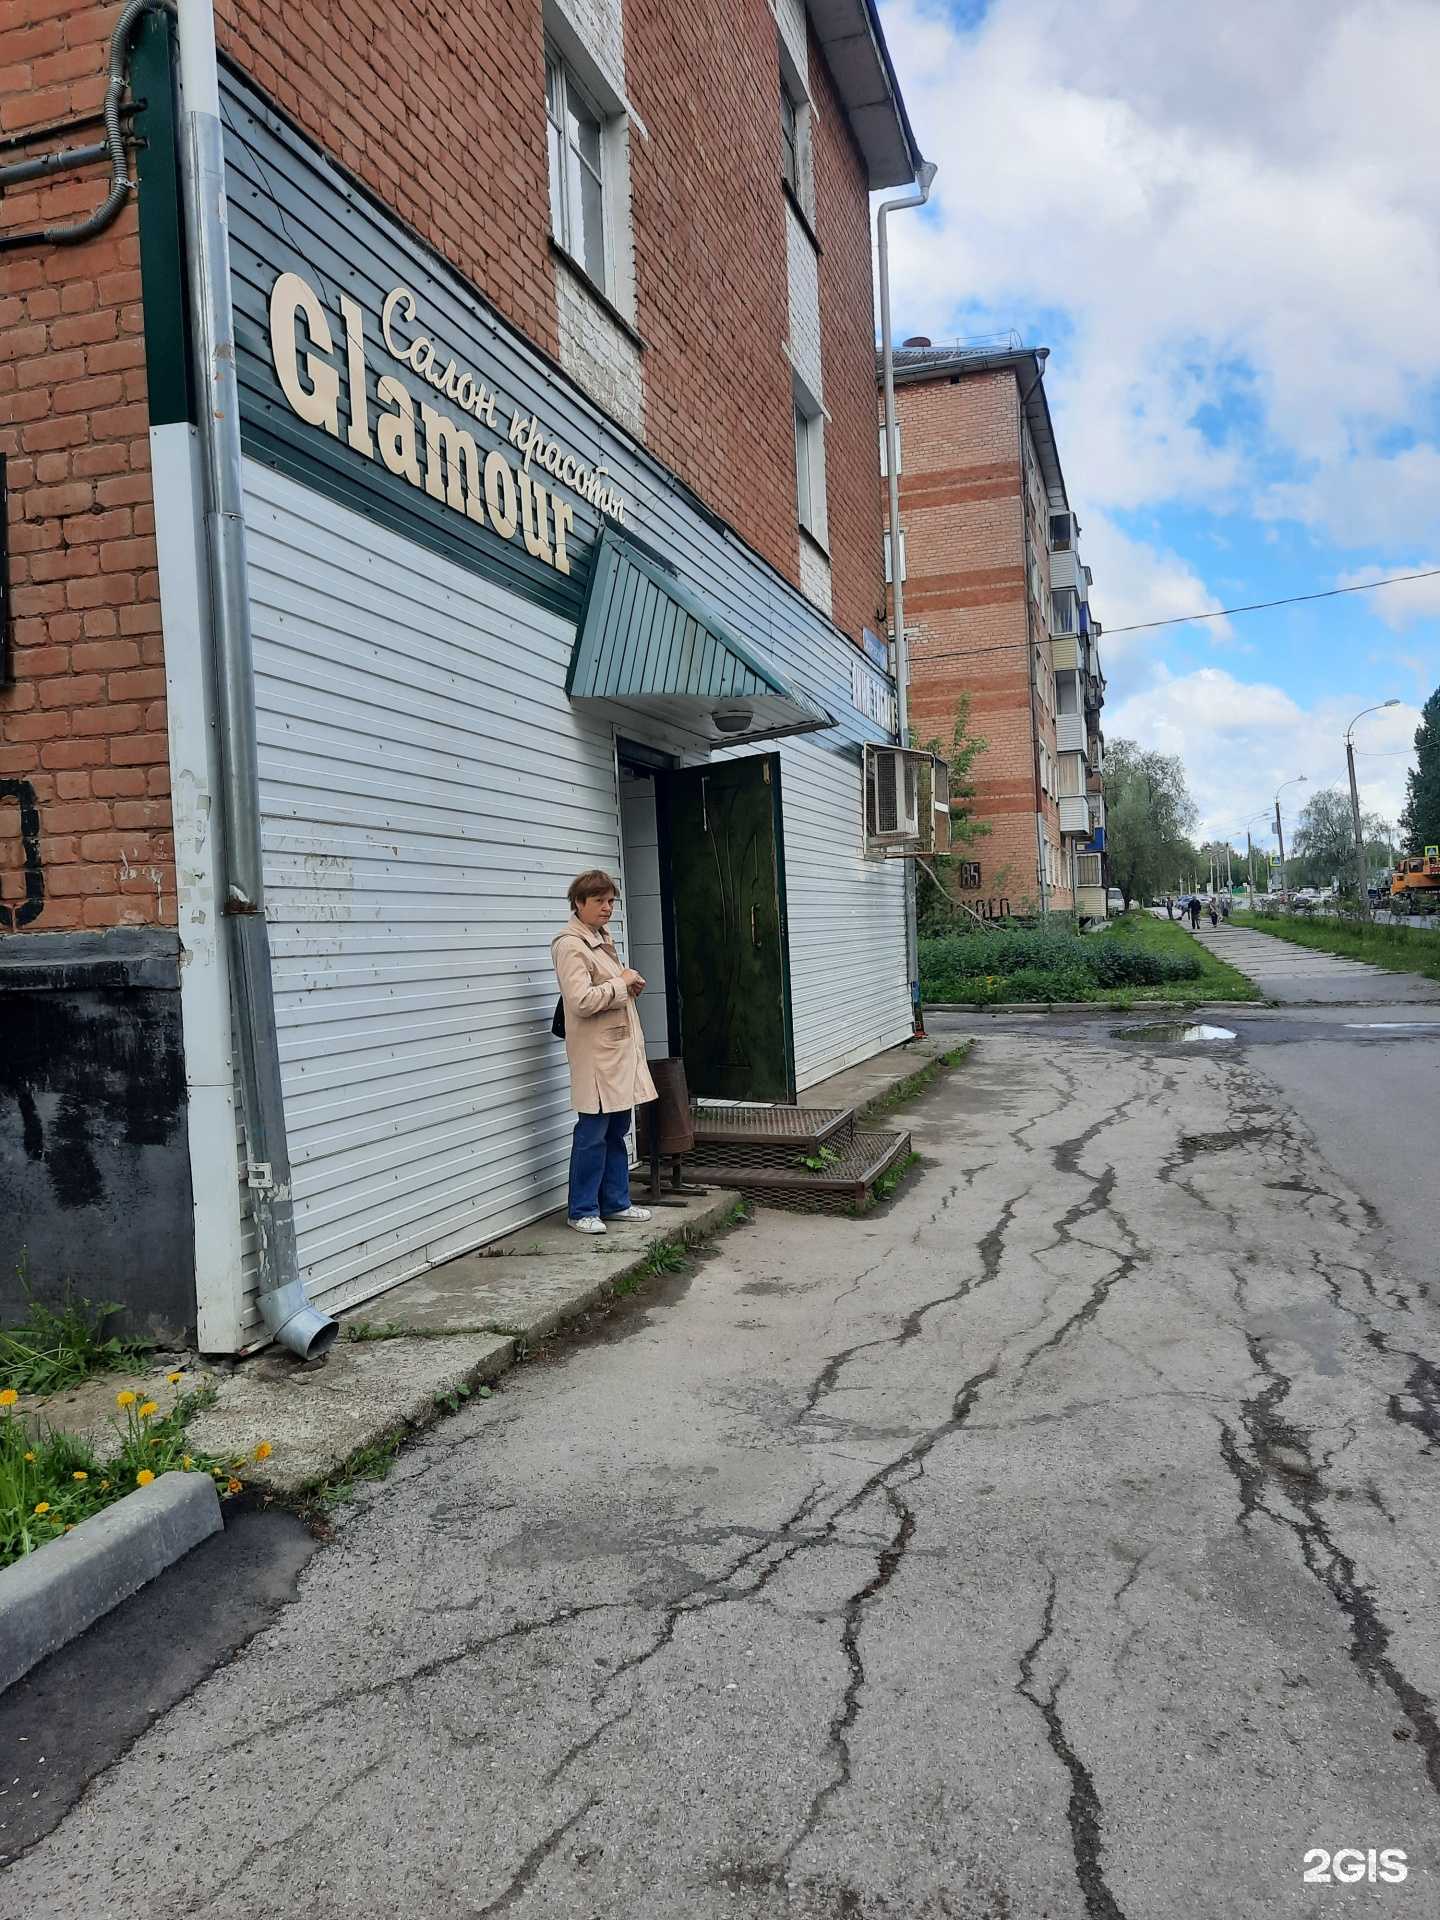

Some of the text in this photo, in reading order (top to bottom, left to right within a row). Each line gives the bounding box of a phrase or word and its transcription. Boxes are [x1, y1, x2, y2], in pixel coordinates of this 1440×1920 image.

[270, 272, 576, 576] Glamour
[382, 287, 626, 524] Салон красоты
